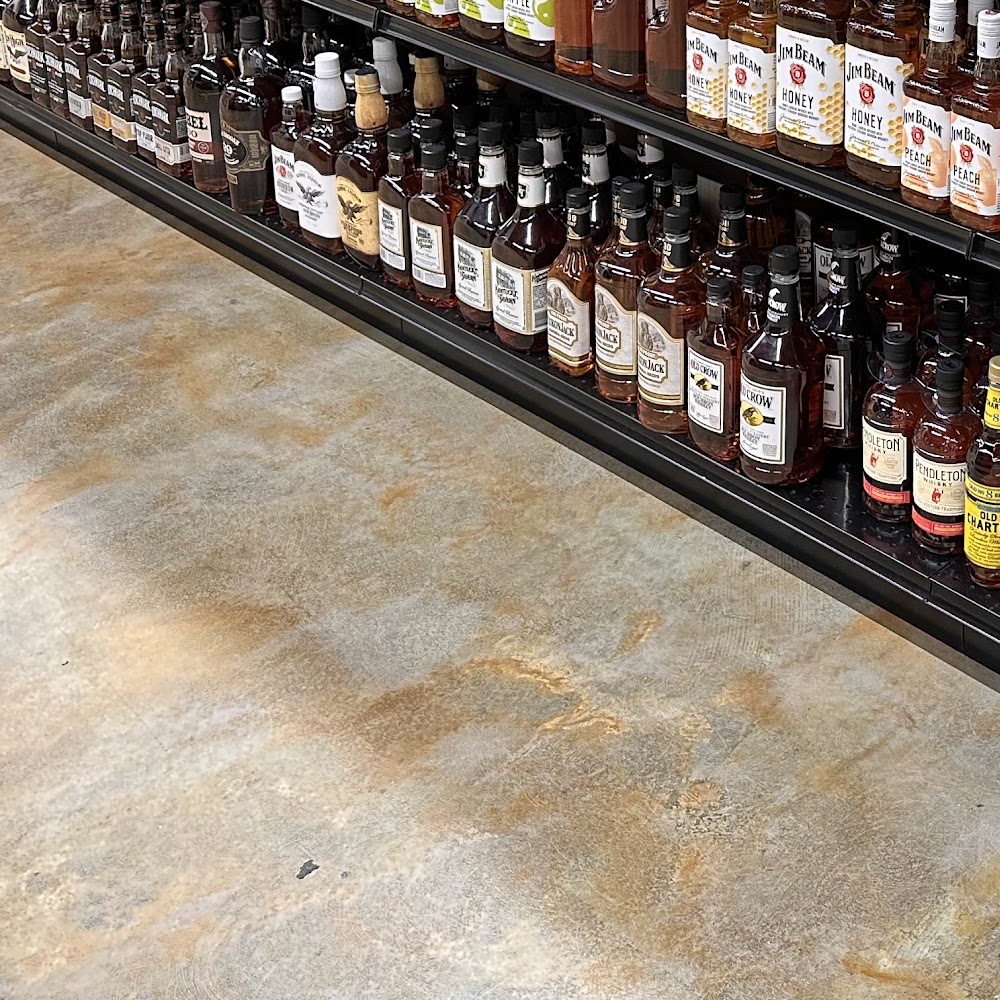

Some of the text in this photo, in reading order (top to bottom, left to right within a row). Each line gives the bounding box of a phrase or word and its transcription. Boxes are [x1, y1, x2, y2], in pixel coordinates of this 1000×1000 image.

[777, 43, 827, 77] JIM BEAM
[846, 60, 896, 98] JIM BEAM
[782, 87, 814, 110] HONEY
[851, 107, 883, 130] HONEY
[953, 164, 981, 186] PEACH
[559, 325, 575, 336] JACK
[691, 360, 718, 379] OLD CROW
[747, 393, 772, 409] CROW
[915, 459, 966, 482] PENDLETON
[923, 476, 953, 487] WHISKY
[979, 510, 998, 522] OLD
